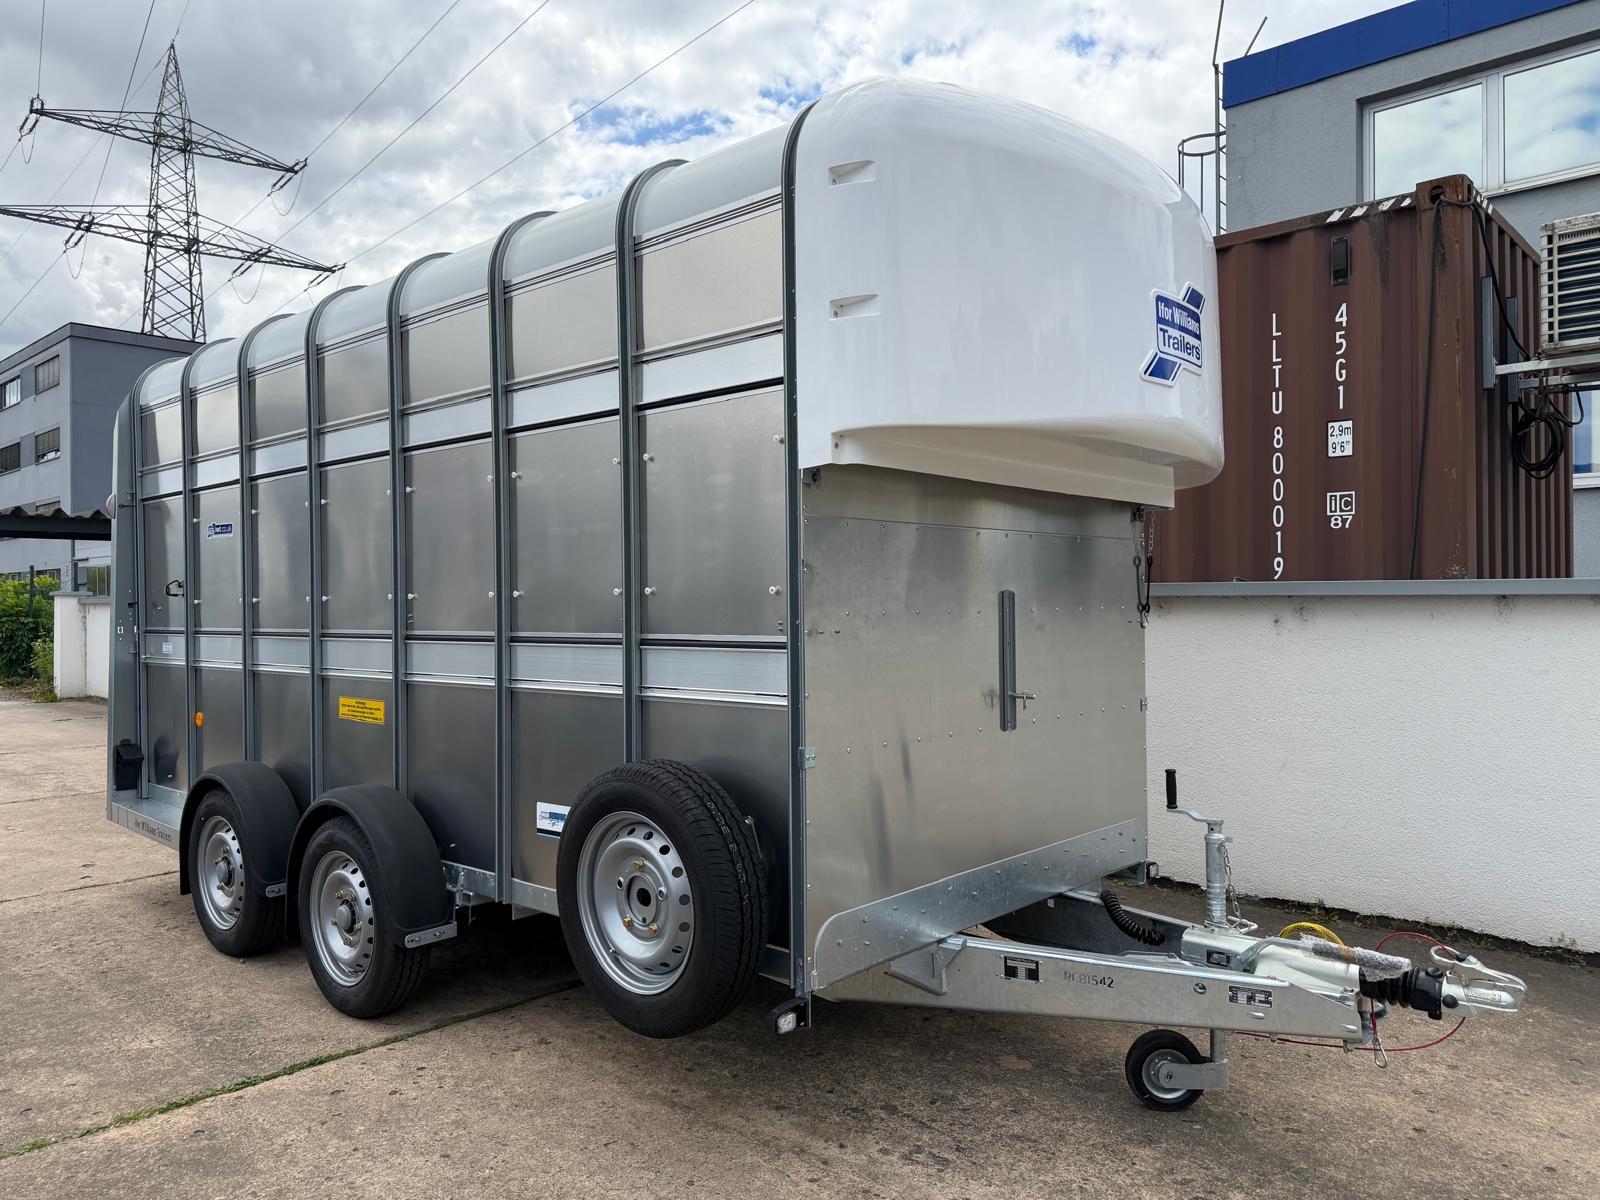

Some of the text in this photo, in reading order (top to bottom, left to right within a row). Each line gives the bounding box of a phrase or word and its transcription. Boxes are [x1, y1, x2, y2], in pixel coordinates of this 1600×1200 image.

[1158, 301, 1200, 334] Ifor Williams
[1159, 327, 1201, 361] Trailers
[1335, 303, 1347, 410] 45G1
[1272, 313, 1284, 580] LLTU 800019
[1329, 424, 1352, 438] 2,9m
[1330, 515, 1353, 529] 87
